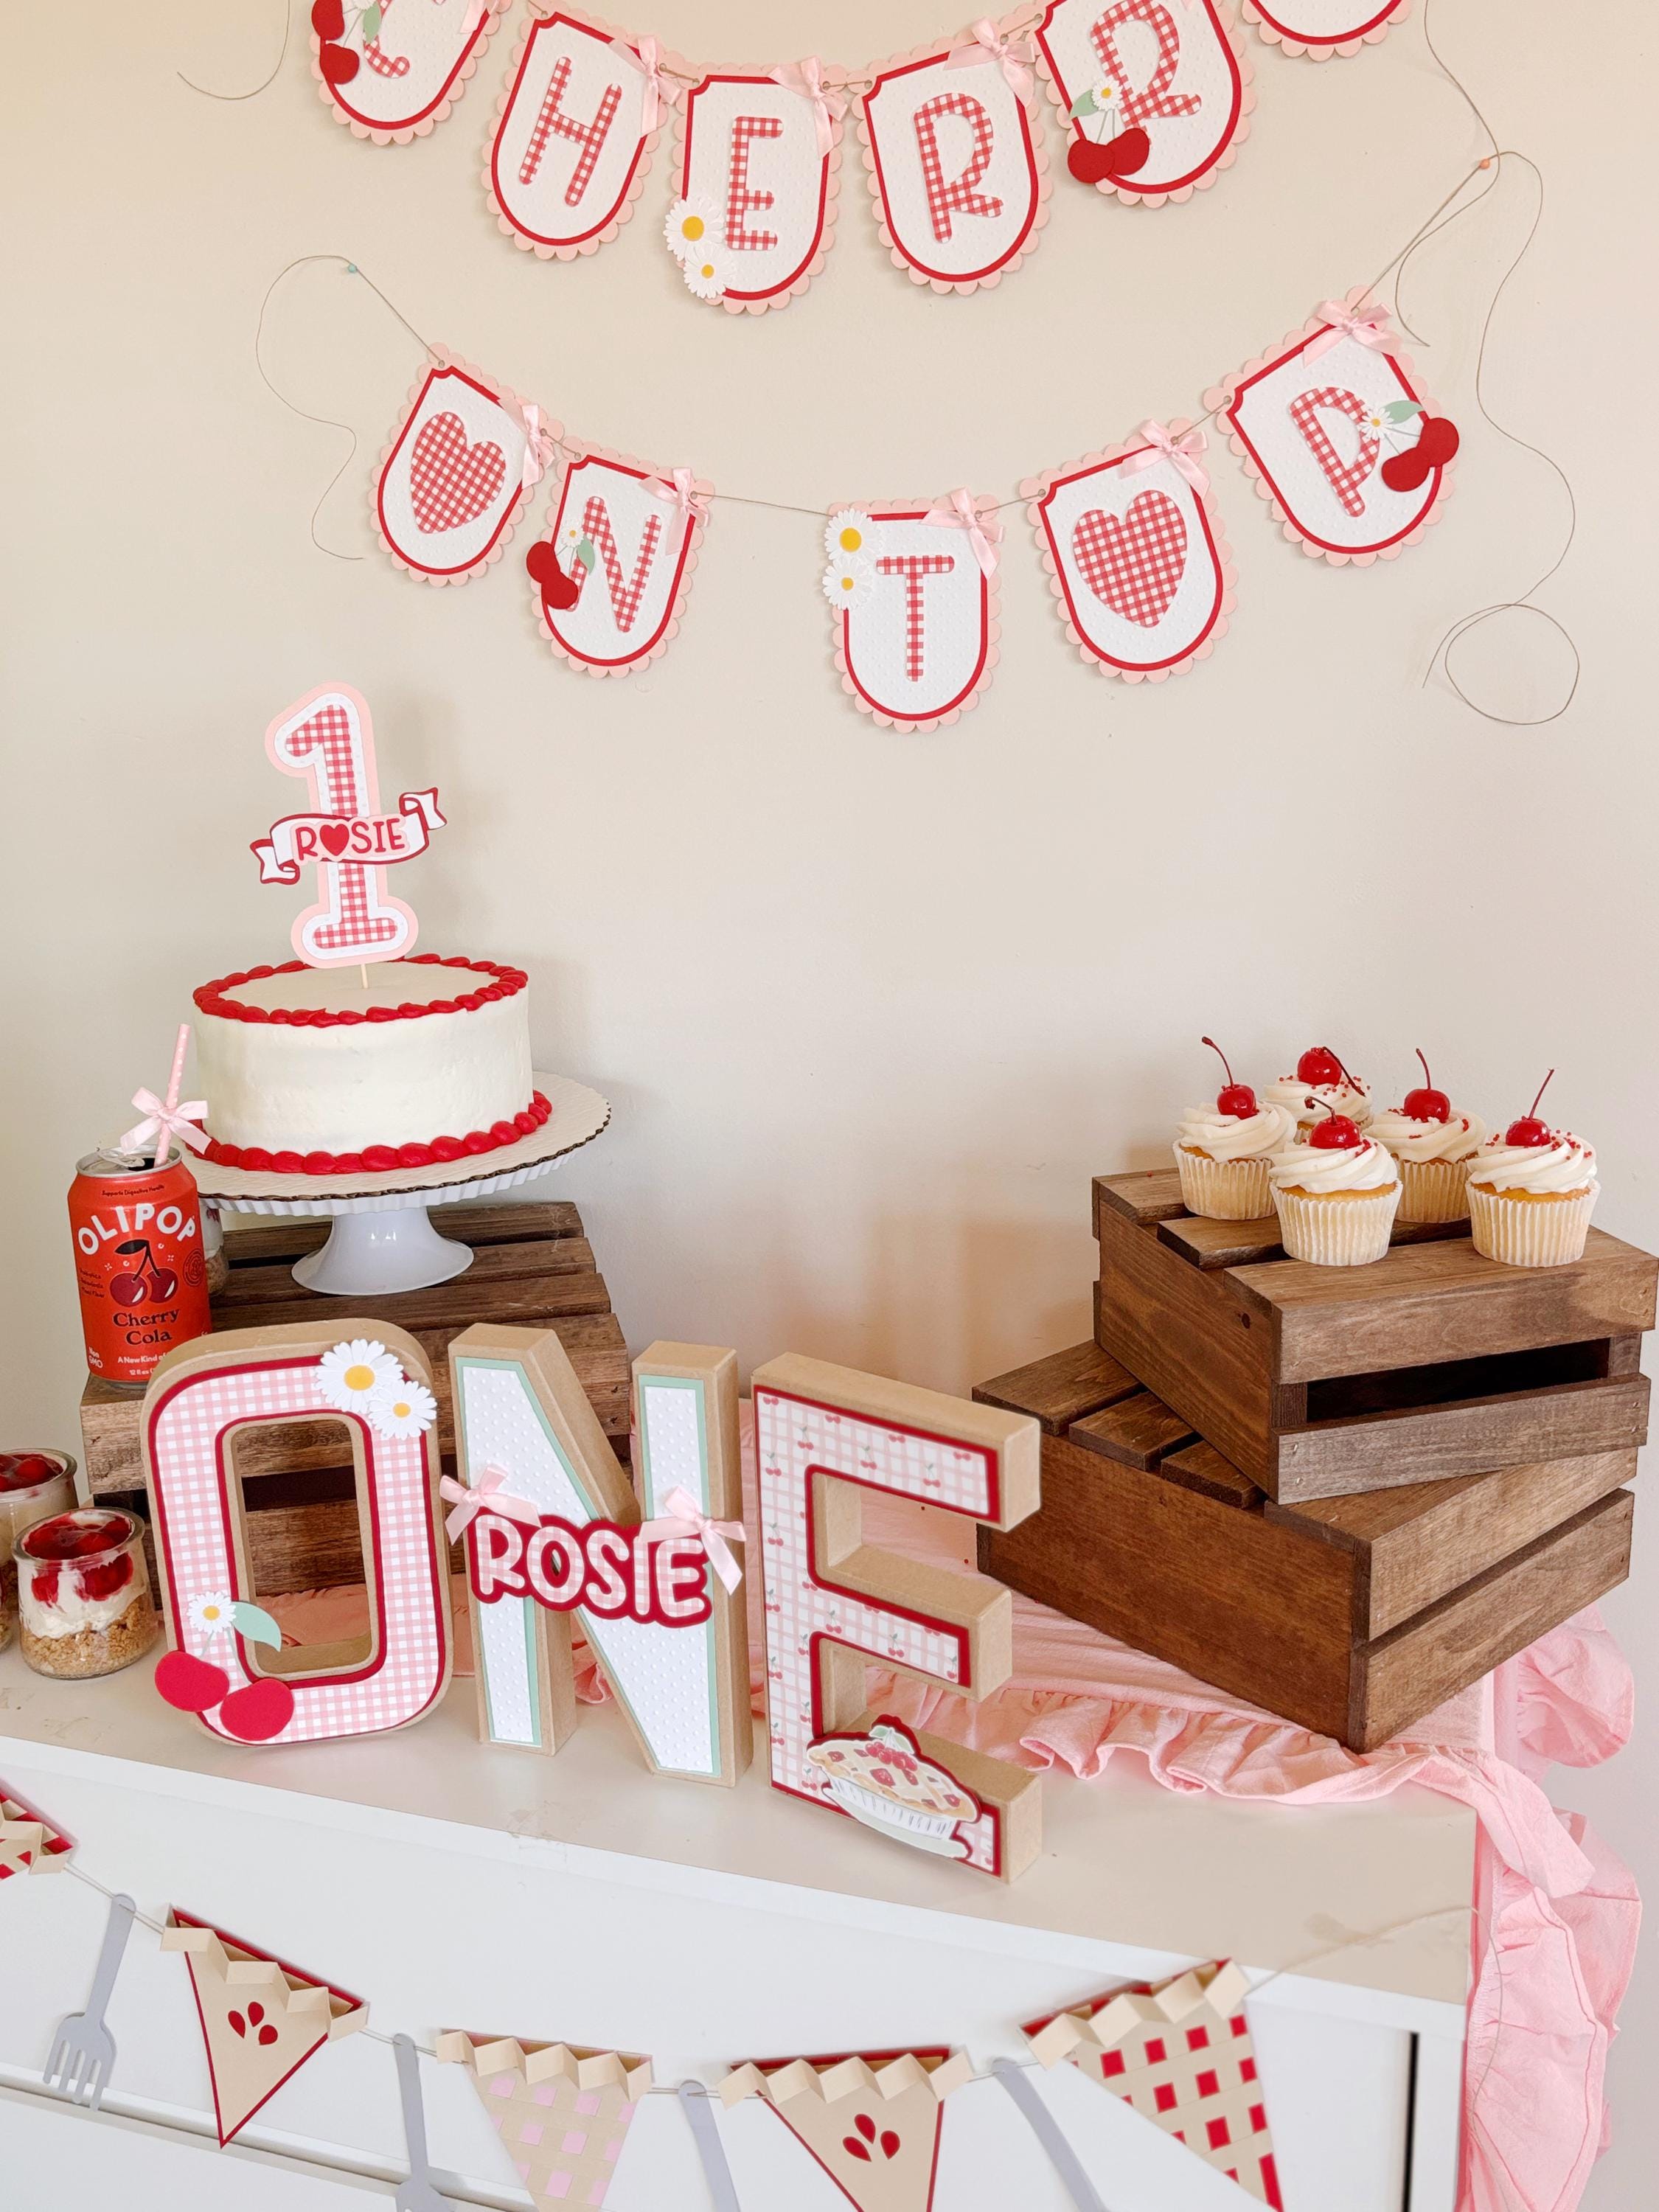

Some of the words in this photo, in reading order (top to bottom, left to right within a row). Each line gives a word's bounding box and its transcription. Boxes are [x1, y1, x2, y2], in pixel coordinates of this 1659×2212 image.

[276, 694, 407, 958] 1
[77, 1203, 196, 1255] OLIPOP
[113, 1308, 180, 1327] Cherry
[125, 1329, 173, 1346] Cola
[88, 1346, 100, 1358] Non
[124, 1356, 140, 1364] New
[140, 1354, 158, 1363] Kind
[474, 1514, 707, 1618] ROSIE
